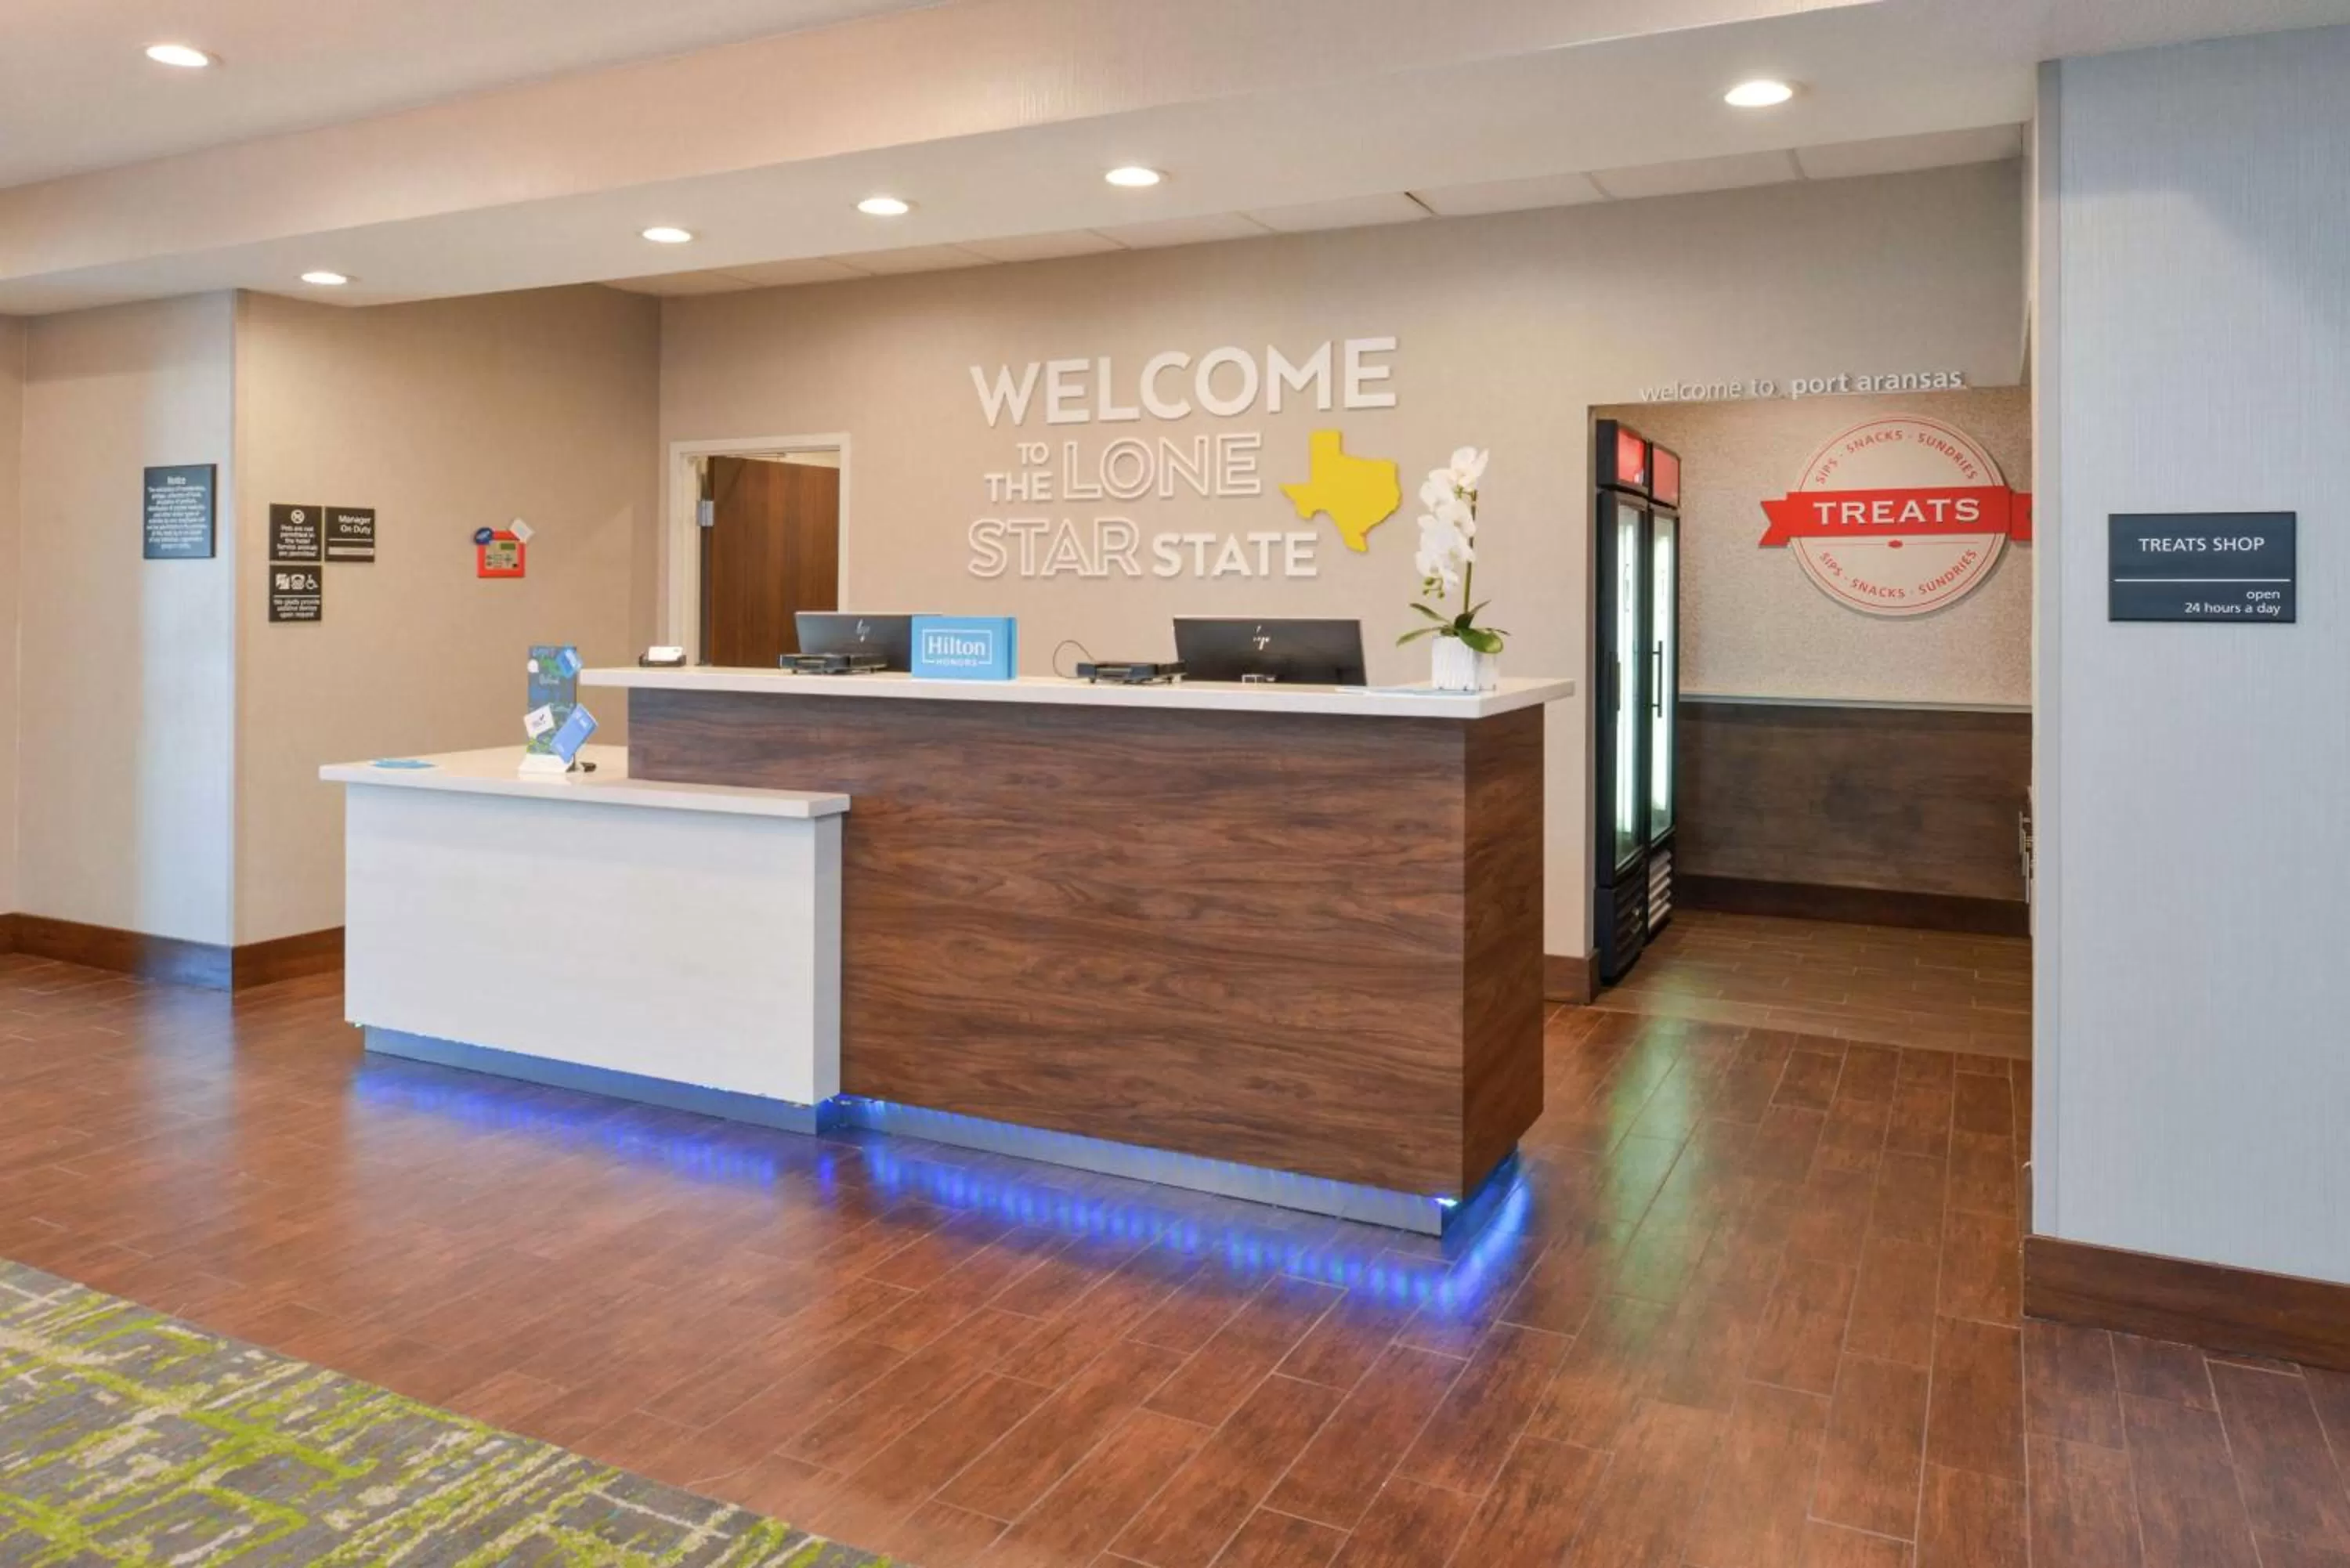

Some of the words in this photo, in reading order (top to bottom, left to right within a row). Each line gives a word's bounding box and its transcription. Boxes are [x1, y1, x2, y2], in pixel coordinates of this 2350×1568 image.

[969, 336, 1397, 428] WELCOME
[1640, 379, 1743, 402] welcome
[1752, 378, 1776, 397] to
[1791, 372, 1849, 400] port
[1857, 370, 1963, 392] aransas
[1016, 442, 1050, 467] TO
[1815, 457, 1838, 485] SIPS
[1846, 430, 1904, 453] SNACKS
[1917, 432, 1979, 480] SUNDRIES
[984, 471, 1053, 503] THE
[1061, 432, 1261, 500] LONE
[338, 515, 371, 525] Manager
[1813, 497, 1981, 526] TREATS
[340, 524, 352, 533] On
[353, 525, 371, 534] Duty
[967, 515, 1141, 578] STAR
[1152, 532, 1318, 578] STATE
[2138, 537, 2207, 551] TREATS
[2213, 537, 2265, 551] SHOP
[1819, 551, 1843, 577] SIPS
[1851, 577, 1906, 599] SNACKS
[1918, 548, 1977, 595] SUNDRIES
[2246, 590, 2281, 602] open
[2185, 602, 2200, 613] 24
[2204, 602, 2241, 613] hours
[2245, 605, 2253, 613] a
[2257, 602, 2281, 616] day
[927, 635, 986, 656] Hilton
[936, 659, 979, 667] HONORS
